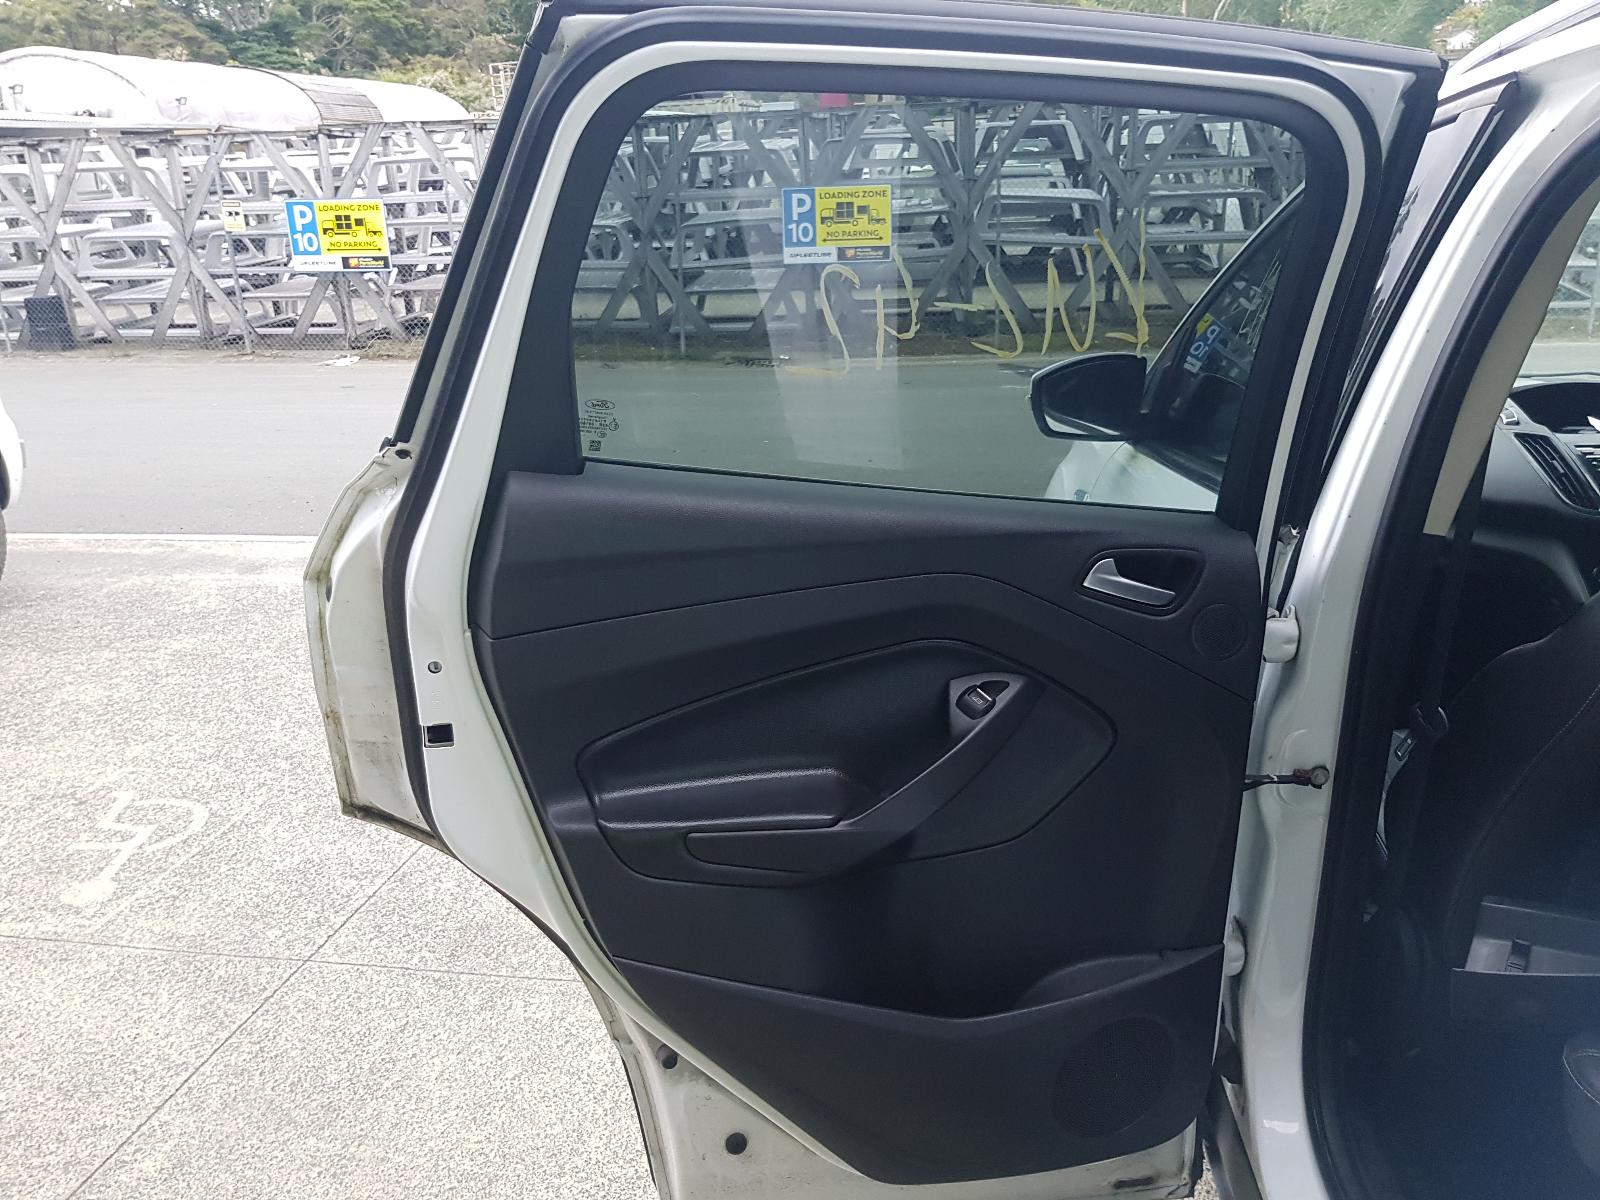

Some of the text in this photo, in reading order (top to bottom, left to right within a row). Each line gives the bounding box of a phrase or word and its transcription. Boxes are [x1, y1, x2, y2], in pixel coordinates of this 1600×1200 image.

[819, 190, 888, 200] LOADING ZONE
[318, 204, 356, 212] LOADING
[791, 193, 812, 221] P
[292, 204, 313, 231] P
[293, 232, 319, 252] 10
[788, 222, 814, 243] 10
[841, 230, 880, 238] PARKING
